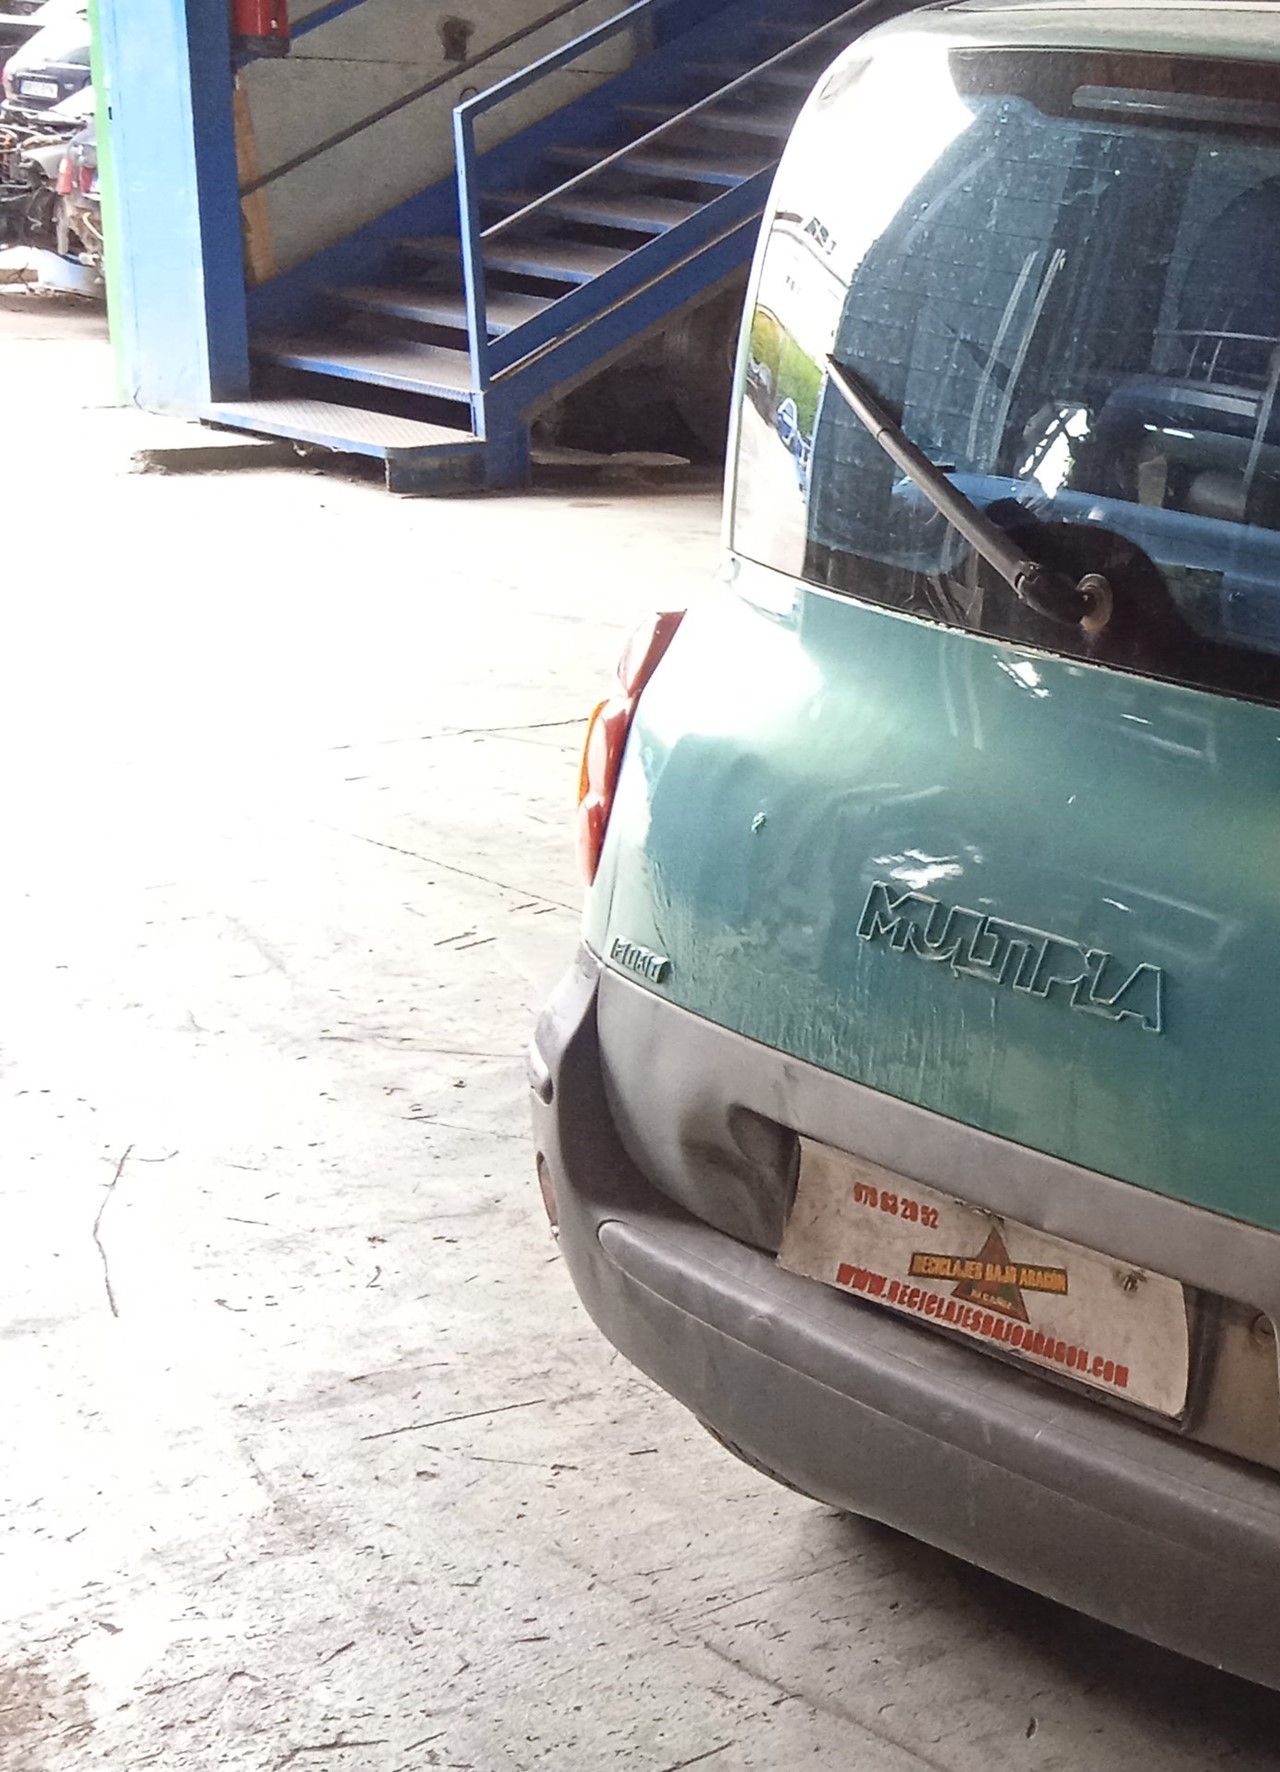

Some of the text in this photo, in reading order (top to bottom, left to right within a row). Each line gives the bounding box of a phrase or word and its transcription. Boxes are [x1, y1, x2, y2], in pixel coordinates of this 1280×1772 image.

[856, 879, 1163, 1032] MULTIPLA
[921, 1205, 939, 1230] 52
[985, 1263, 1017, 1285] BAJO
